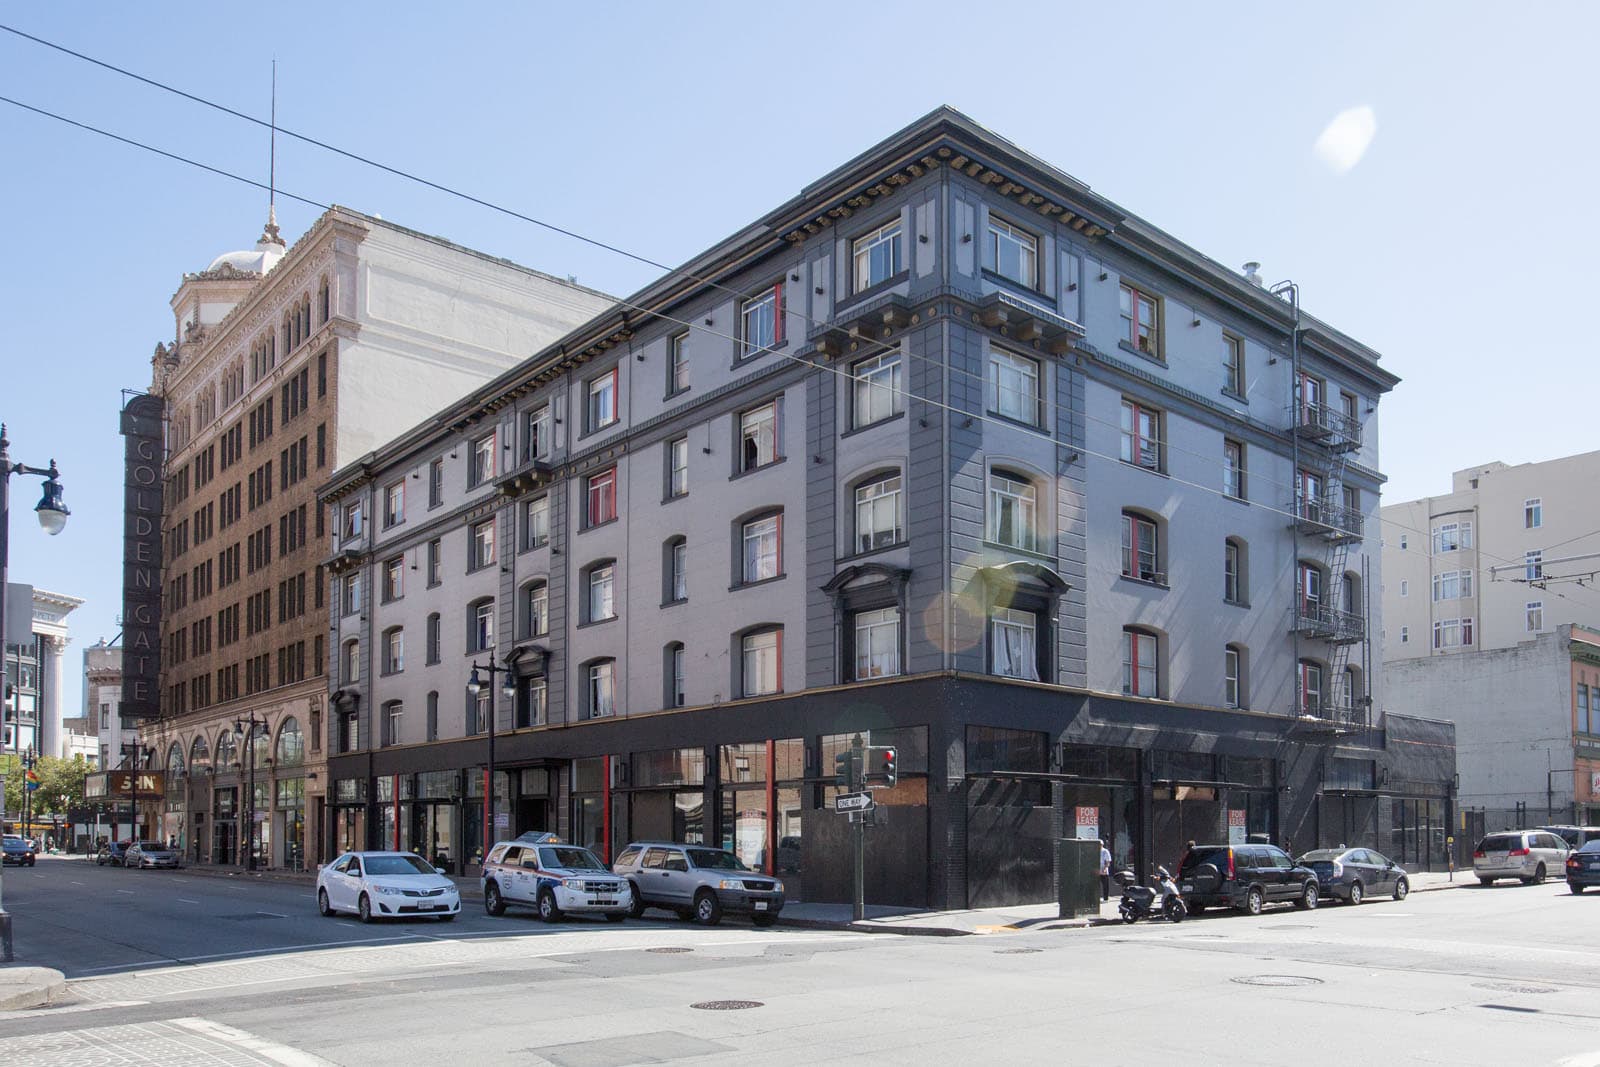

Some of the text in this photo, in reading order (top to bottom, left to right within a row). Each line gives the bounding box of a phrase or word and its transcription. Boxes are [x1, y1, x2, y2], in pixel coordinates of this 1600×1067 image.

[133, 439, 157, 701] GOLDEN GATE
[839, 799, 850, 808] ONE
[1080, 807, 1095, 816] FOR
[1231, 810, 1243, 818] FOR
[1077, 816, 1098, 825] LEASE
